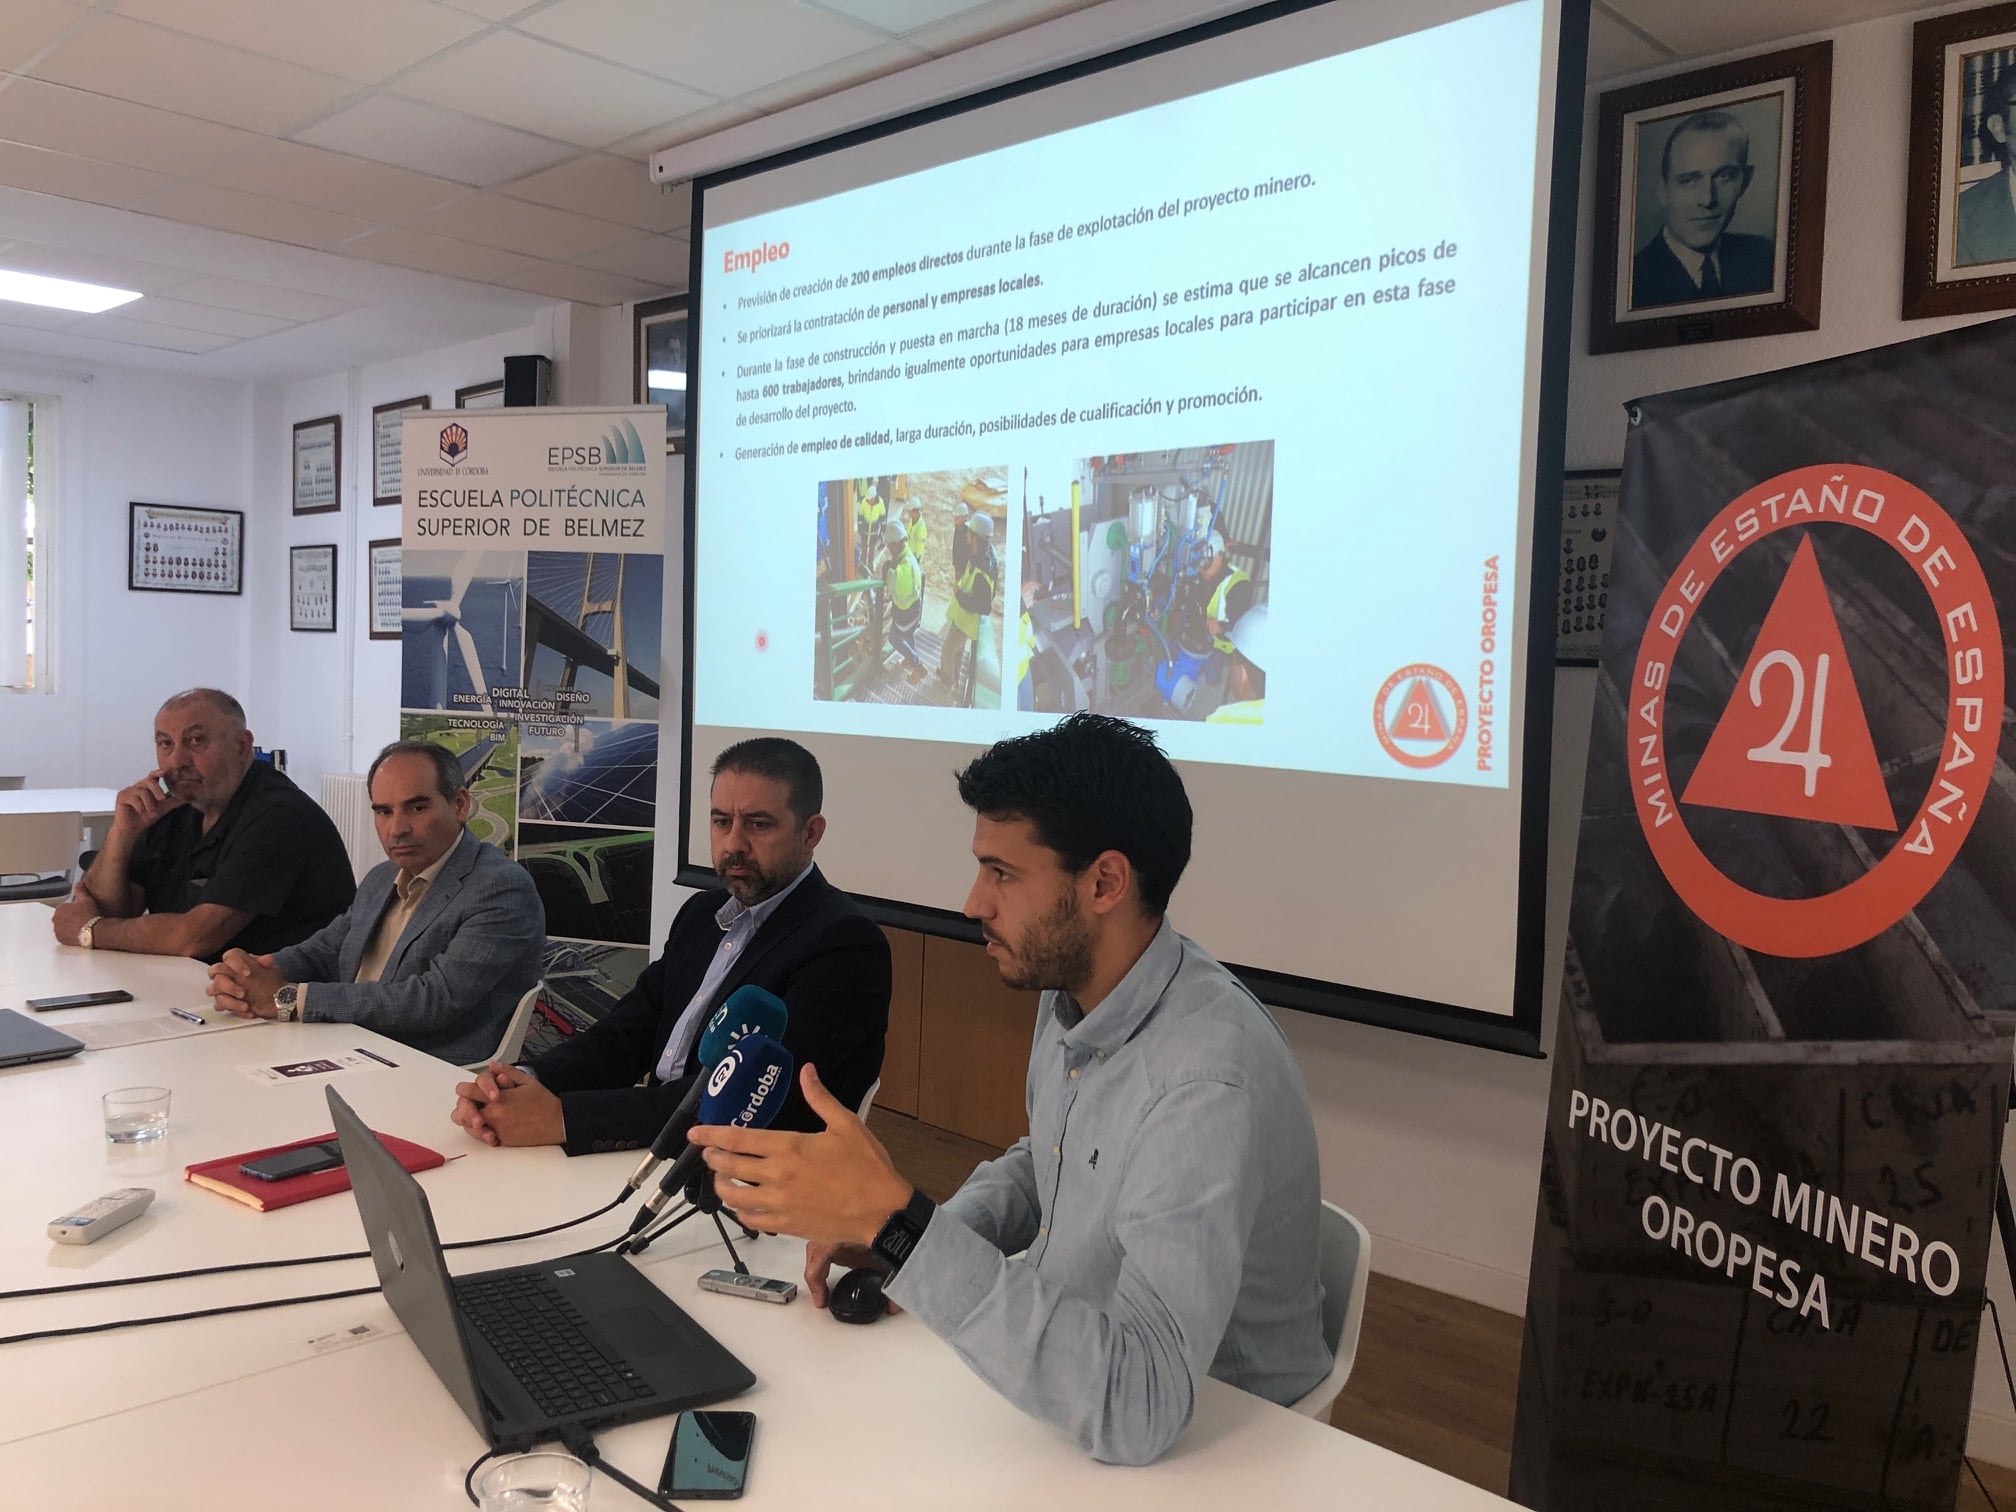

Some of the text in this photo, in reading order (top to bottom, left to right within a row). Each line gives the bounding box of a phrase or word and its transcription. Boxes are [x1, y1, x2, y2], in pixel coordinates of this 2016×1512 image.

[739, 174, 1315, 309] Previsión de creación de 200 empleos directos durante la fase de explotación del proyecto minero.
[723, 240, 790, 274] Empleo
[737, 240, 1457, 378] Durante la fase de construcción y puesta en marcha (18 meses de duración) se estima que se alcancen picos de
[738, 273, 1043, 343] Se priorizará la contratación de personal y empresas locales.
[737, 278, 1455, 402] hasta 600 trabajadores, brindando igualmente oportunidades para empresas locales para participar en esta fase
[735, 386, 1262, 460] Generación de empleo de calidad, larga duración, posibilidades de cualificación y promoción.
[736, 401, 856, 426] de desarrollo del proyecto.
[547, 446, 601, 465] EPSB
[418, 485, 646, 508] ESCUELA POLITÉCNICA
[417, 518, 645, 537] SUPERIOR DE BELMEZ
[1477, 554, 1499, 771] PROYECTO OROPESA
[1639, 474, 1983, 856] MINAS DE ESTAÑO DE ESPAÑA
[453, 693, 492, 704] ENERGÍA
[492, 687, 530, 699] DIGITAL
[499, 698, 555, 710] INNOVACIÓN
[556, 690, 590, 703] DISEÑO
[448, 718, 504, 729] TECNOLOGÍA
[514, 712, 584, 724] INVESTIGACIÓN
[490, 733, 506, 742] BIM
[529, 726, 565, 737] FUTURO
[1568, 1089, 1960, 1296] PROYECTO MINERO
[1641, 1195, 1831, 1329] OROPESA
